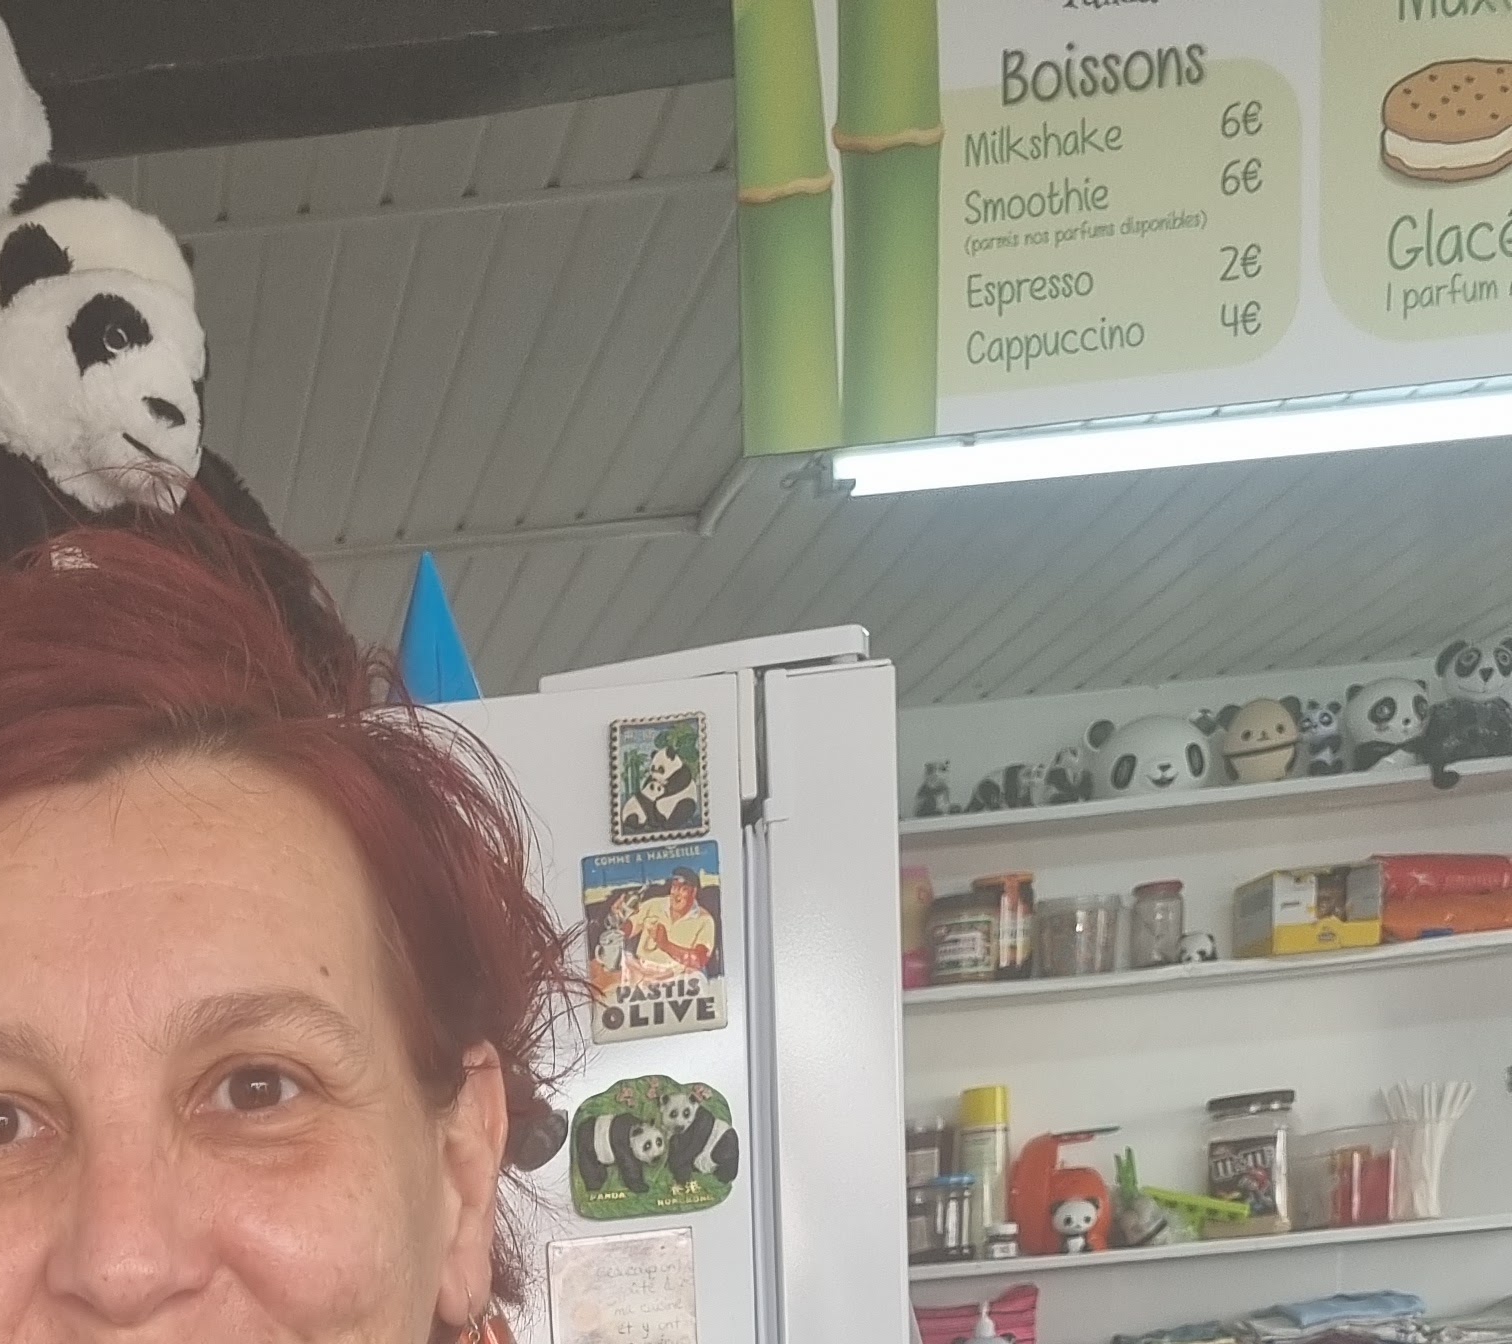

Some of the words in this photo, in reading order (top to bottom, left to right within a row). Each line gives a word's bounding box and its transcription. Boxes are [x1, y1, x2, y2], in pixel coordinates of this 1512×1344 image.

[1001, 41, 1206, 107] Boissons
[964, 117, 1124, 168] Milkshake
[1220, 100, 1264, 139] 6€
[964, 177, 1110, 225] Smoothie
[1220, 158, 1264, 196] 6€
[1024, 230, 1050, 246] nos
[1054, 220, 1116, 248] parfums
[966, 271, 1094, 317] Espresso
[1219, 243, 1263, 281] 2€
[1403, 273, 1498, 320] parfum
[966, 317, 1145, 373] Cappuccino
[1220, 300, 1263, 337] 4€
[601, 996, 716, 1031] OLIVE
[615, 977, 701, 1004] PASTIS
